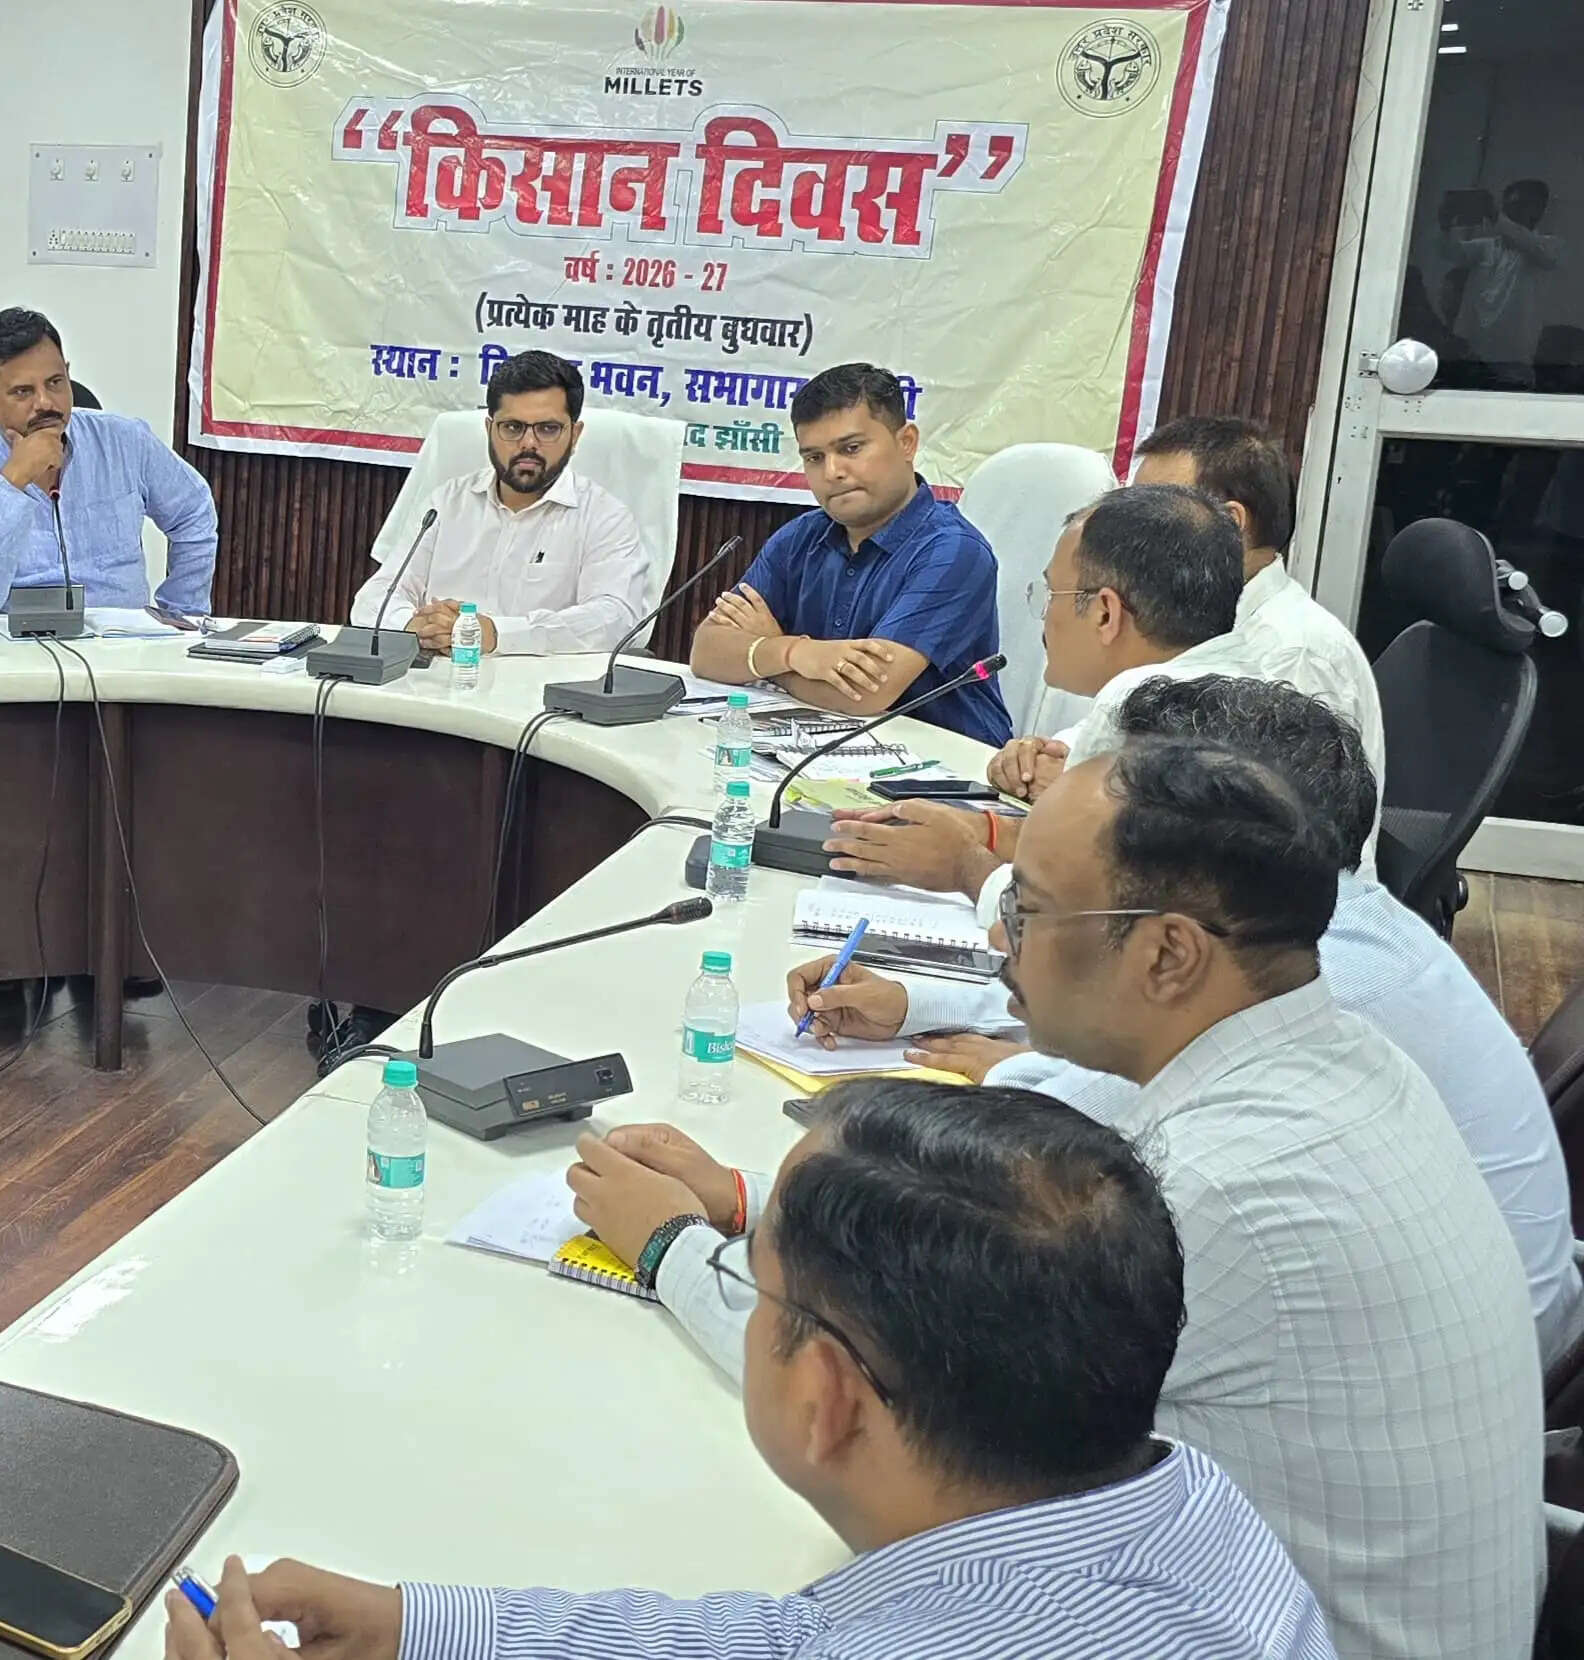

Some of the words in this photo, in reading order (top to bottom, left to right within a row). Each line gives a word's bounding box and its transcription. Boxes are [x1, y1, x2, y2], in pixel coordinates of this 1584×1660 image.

[604, 77, 703, 96] MILLETS
[616, 67, 665, 77] INTERNATIONAL
[667, 68, 685, 77] YEAR
[686, 69, 696, 77] OF
[564, 250, 601, 283] वर्ष
[622, 256, 676, 288] 2026
[702, 262, 728, 292] 27
[475, 291, 558, 333] (प्रत्येक
[563, 304, 609, 334] माह
[614, 301, 642, 336] के
[646, 304, 716, 348] तृतीय
[720, 312, 814, 357] बुधवार)
[370, 344, 442, 381] स्थान
[590, 360, 671, 407] भवन,
[713, 419, 785, 454] झाँसी
